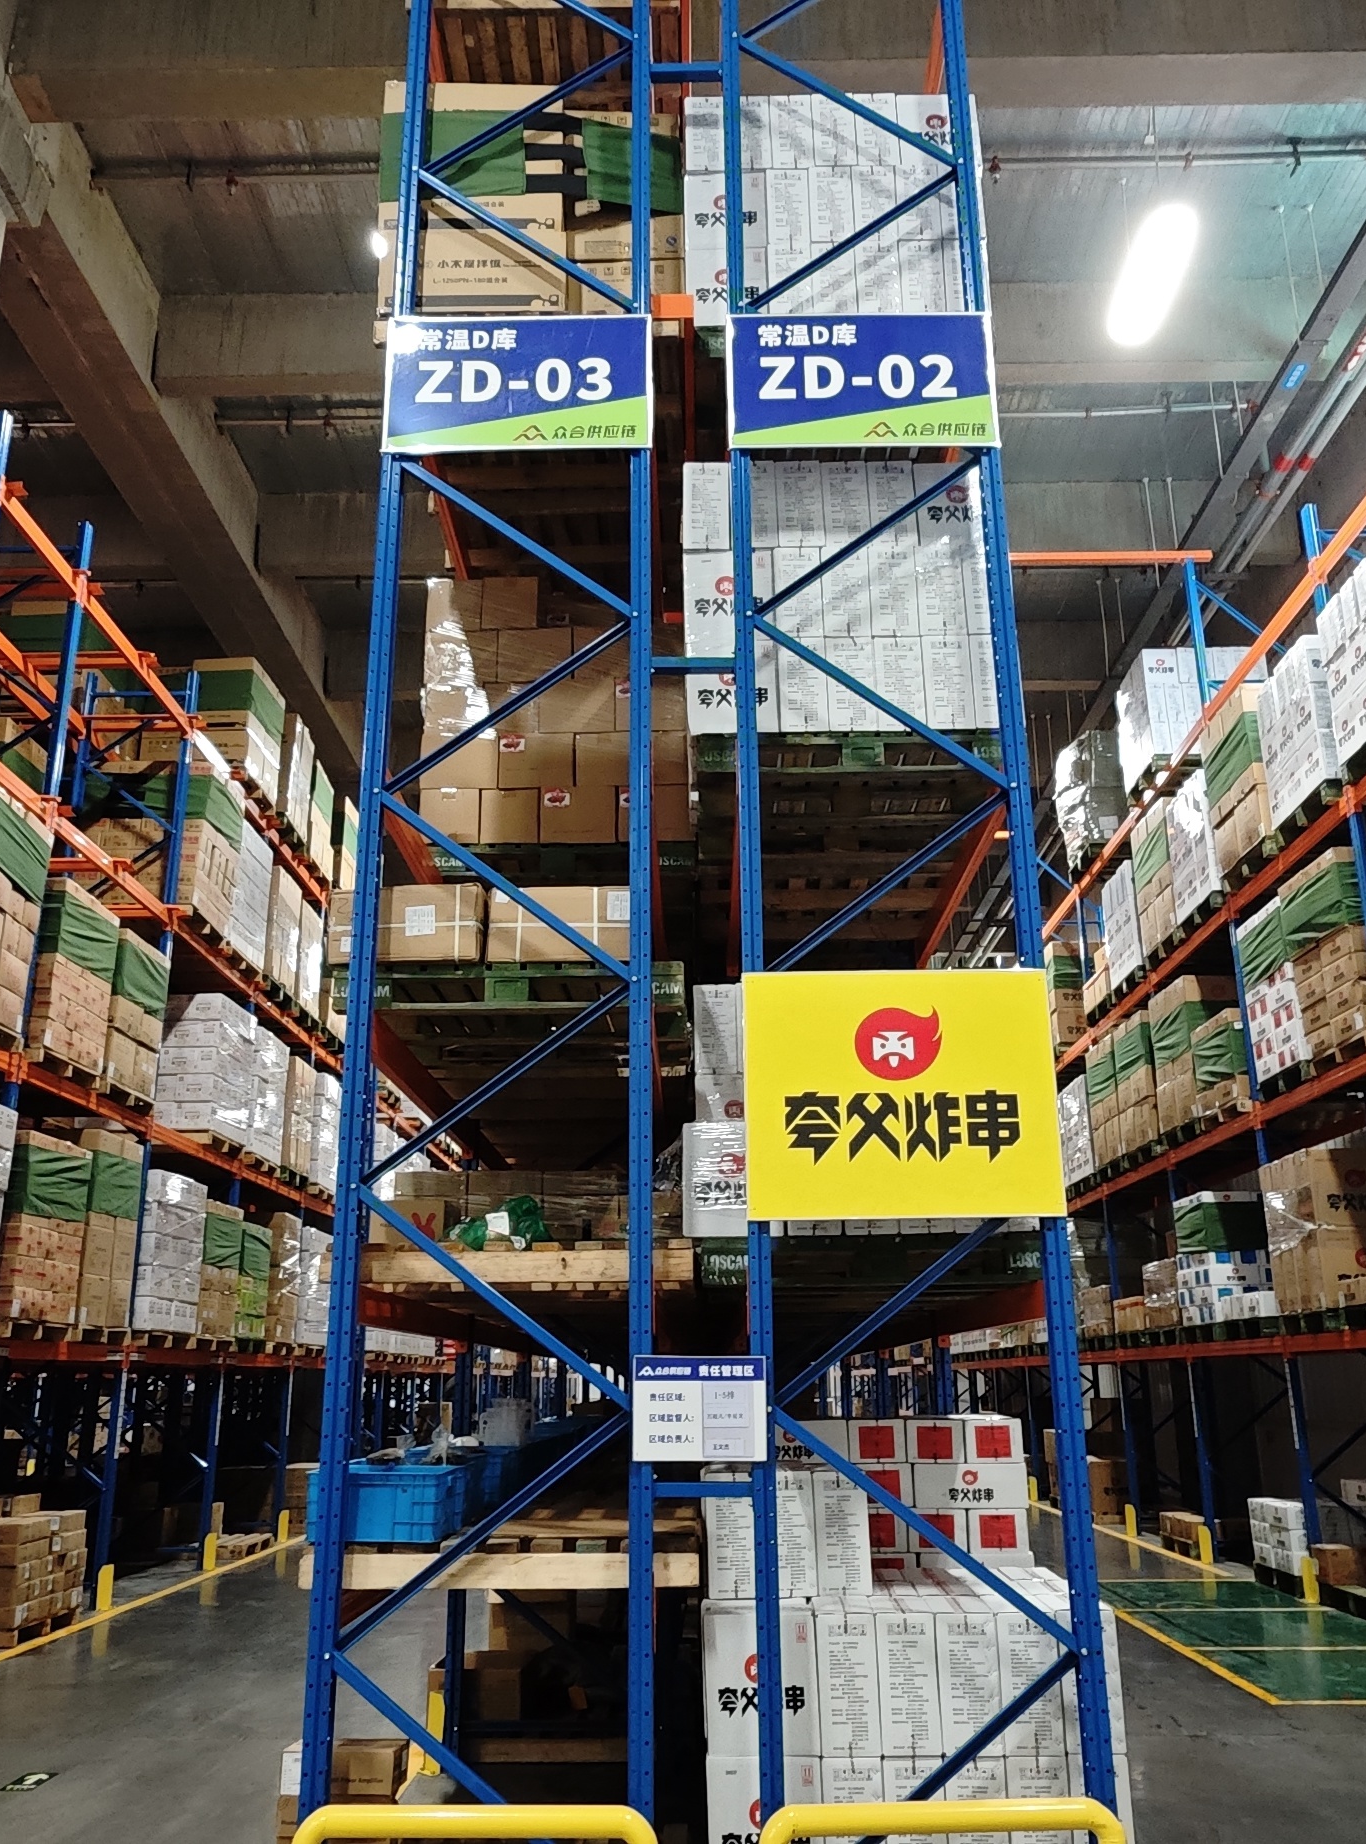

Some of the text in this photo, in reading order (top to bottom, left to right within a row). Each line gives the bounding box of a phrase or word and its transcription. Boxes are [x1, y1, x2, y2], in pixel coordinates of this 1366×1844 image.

[695, 211, 758, 228] 夸父串
[695, 285, 760, 303] 夸父串
[419, 329, 517, 350] 常温D库
[758, 324, 857, 347] 常温D库
[415, 358, 613, 403] ZD-03
[759, 356, 958, 400] ZD-02
[552, 424, 636, 440] 众合供应链
[902, 421, 987, 439] 众合供应链
[697, 687, 769, 709] 夸父串
[785, 1089, 1021, 1167] 夸父炸串
[699, 1365, 755, 1377] 责任管理区
[948, 1487, 995, 1504] 夸父炸串
[718, 1685, 806, 1717] 夸父串
